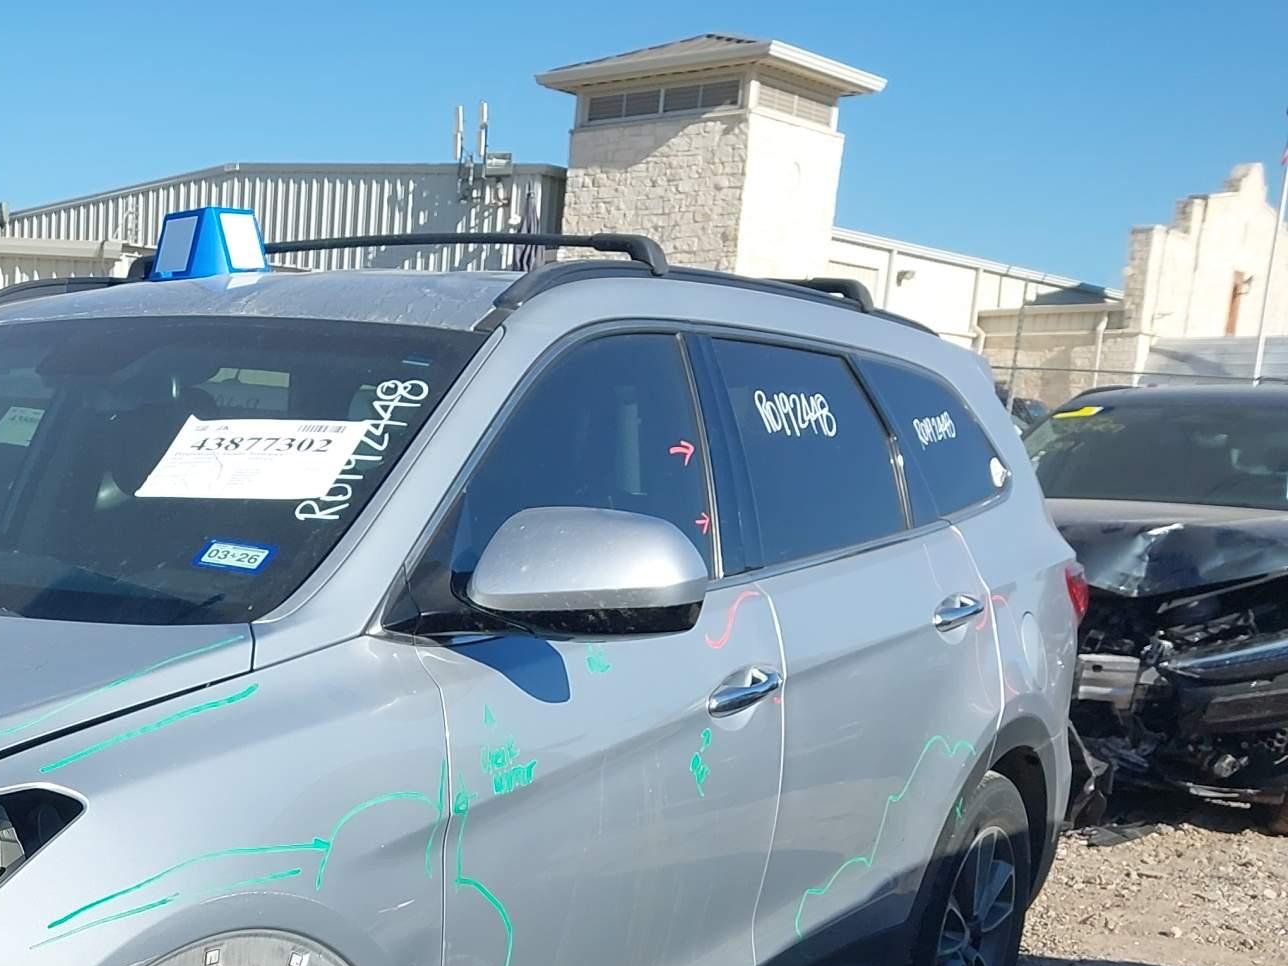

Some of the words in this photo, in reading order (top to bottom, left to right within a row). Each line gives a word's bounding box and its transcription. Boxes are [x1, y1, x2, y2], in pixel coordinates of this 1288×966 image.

[190, 436, 333, 453] 43877302
[207, 548, 230, 560] 03
[235, 552, 260, 565] 26
